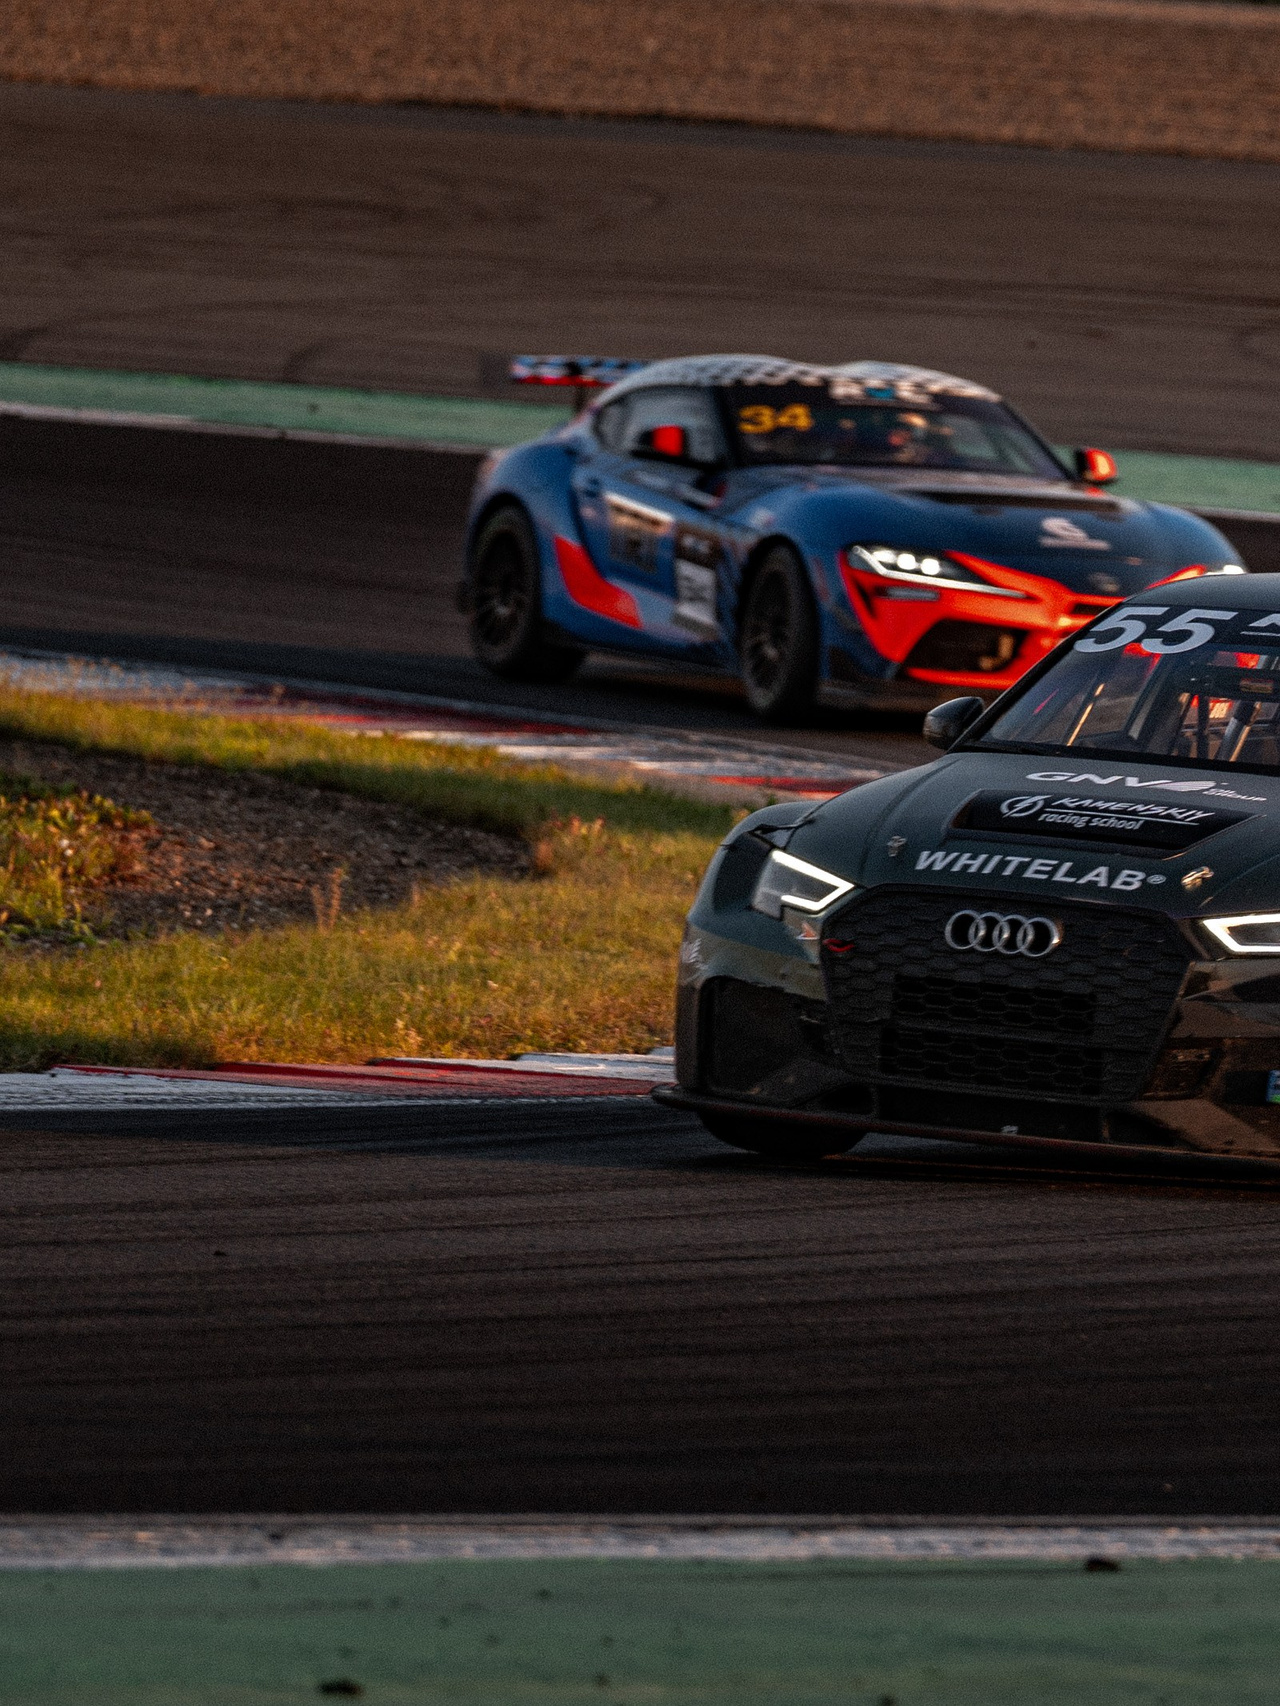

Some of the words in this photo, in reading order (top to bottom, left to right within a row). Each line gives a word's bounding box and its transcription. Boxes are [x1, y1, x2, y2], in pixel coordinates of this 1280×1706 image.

[738, 403, 814, 434] 34
[1073, 607, 1239, 654] 55
[1026, 771, 1172, 787] GNV
[1038, 812, 1087, 828] racing
[1089, 816, 1145, 830] school
[1051, 797, 1216, 822] KAMENSKIY
